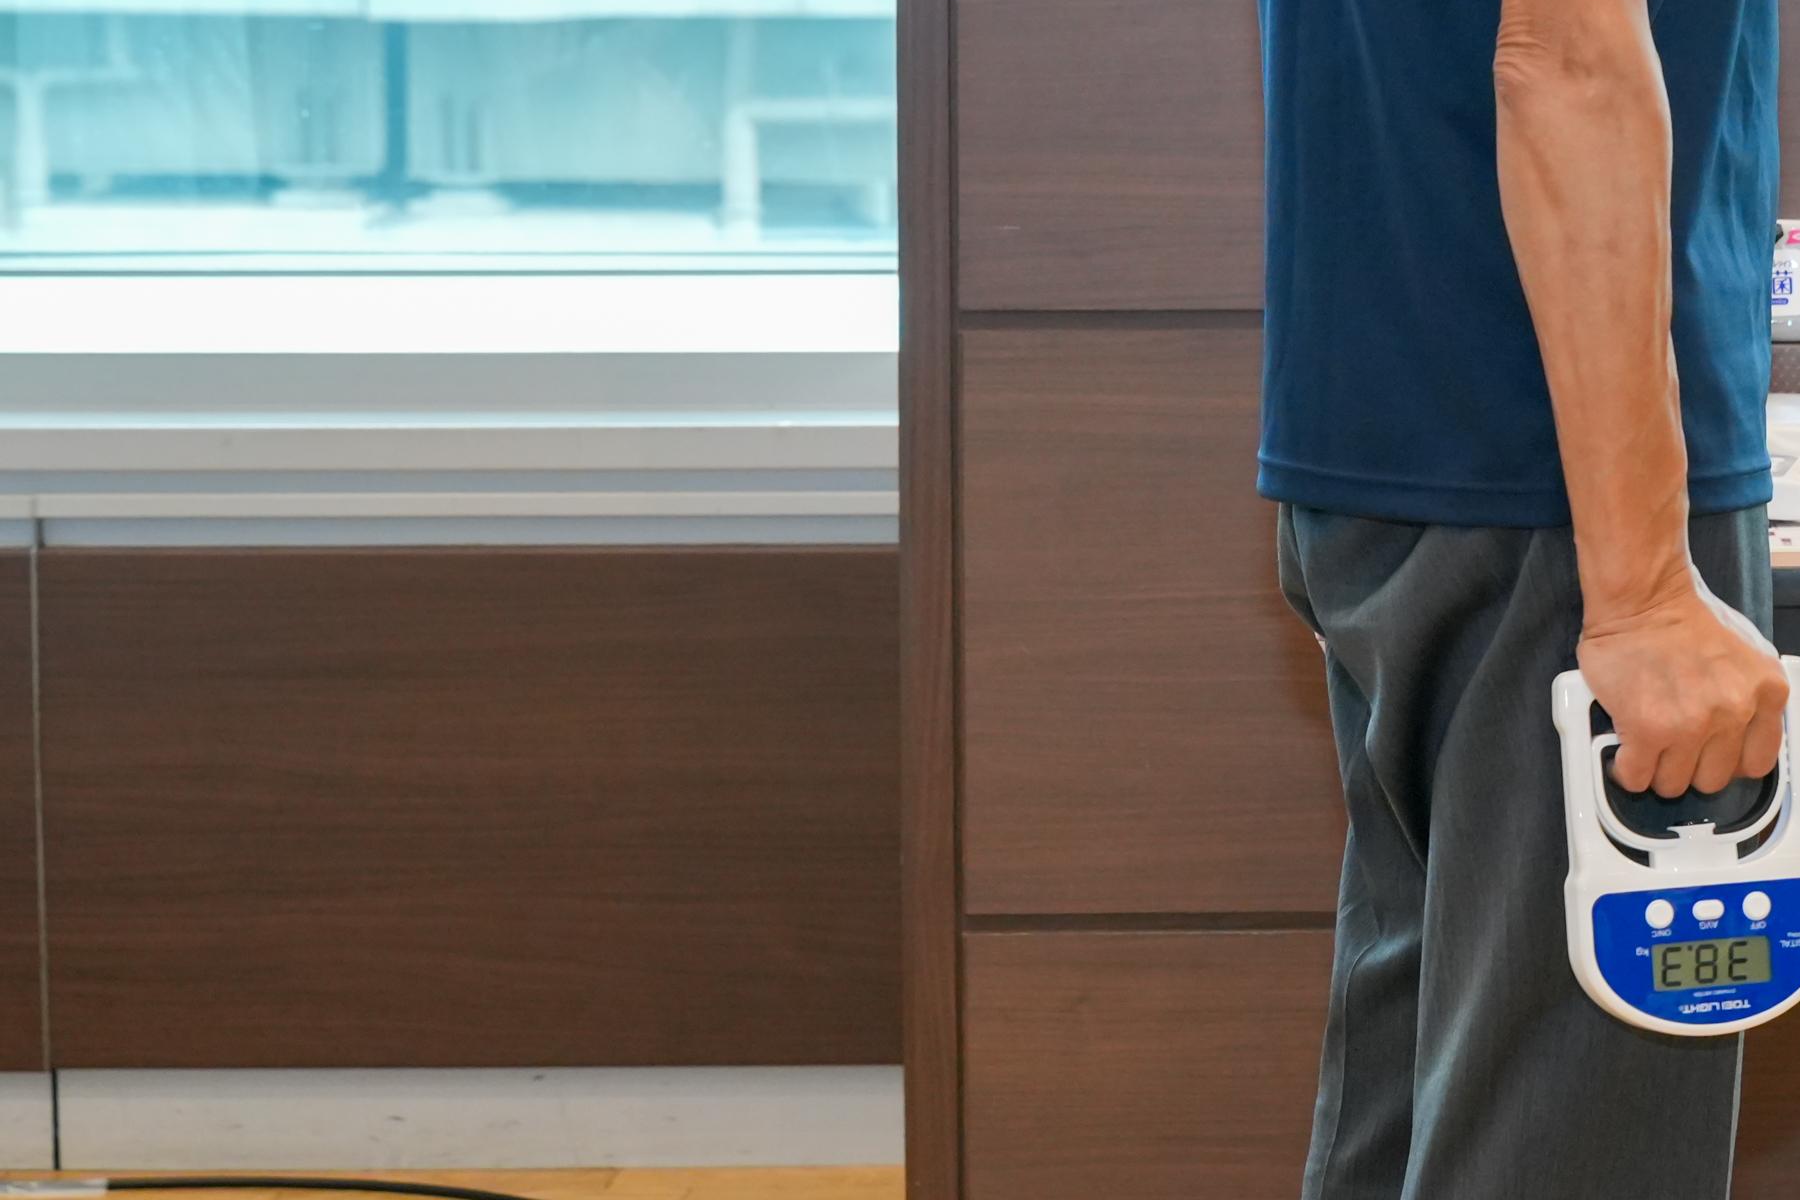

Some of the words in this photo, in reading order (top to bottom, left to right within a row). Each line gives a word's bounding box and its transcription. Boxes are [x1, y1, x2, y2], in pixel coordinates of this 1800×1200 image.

[1698, 921, 1719, 930] AVG
[1750, 921, 1767, 931] OFF
[1635, 947, 1650, 957] kg
[1661, 941, 1749, 988] 38.3
